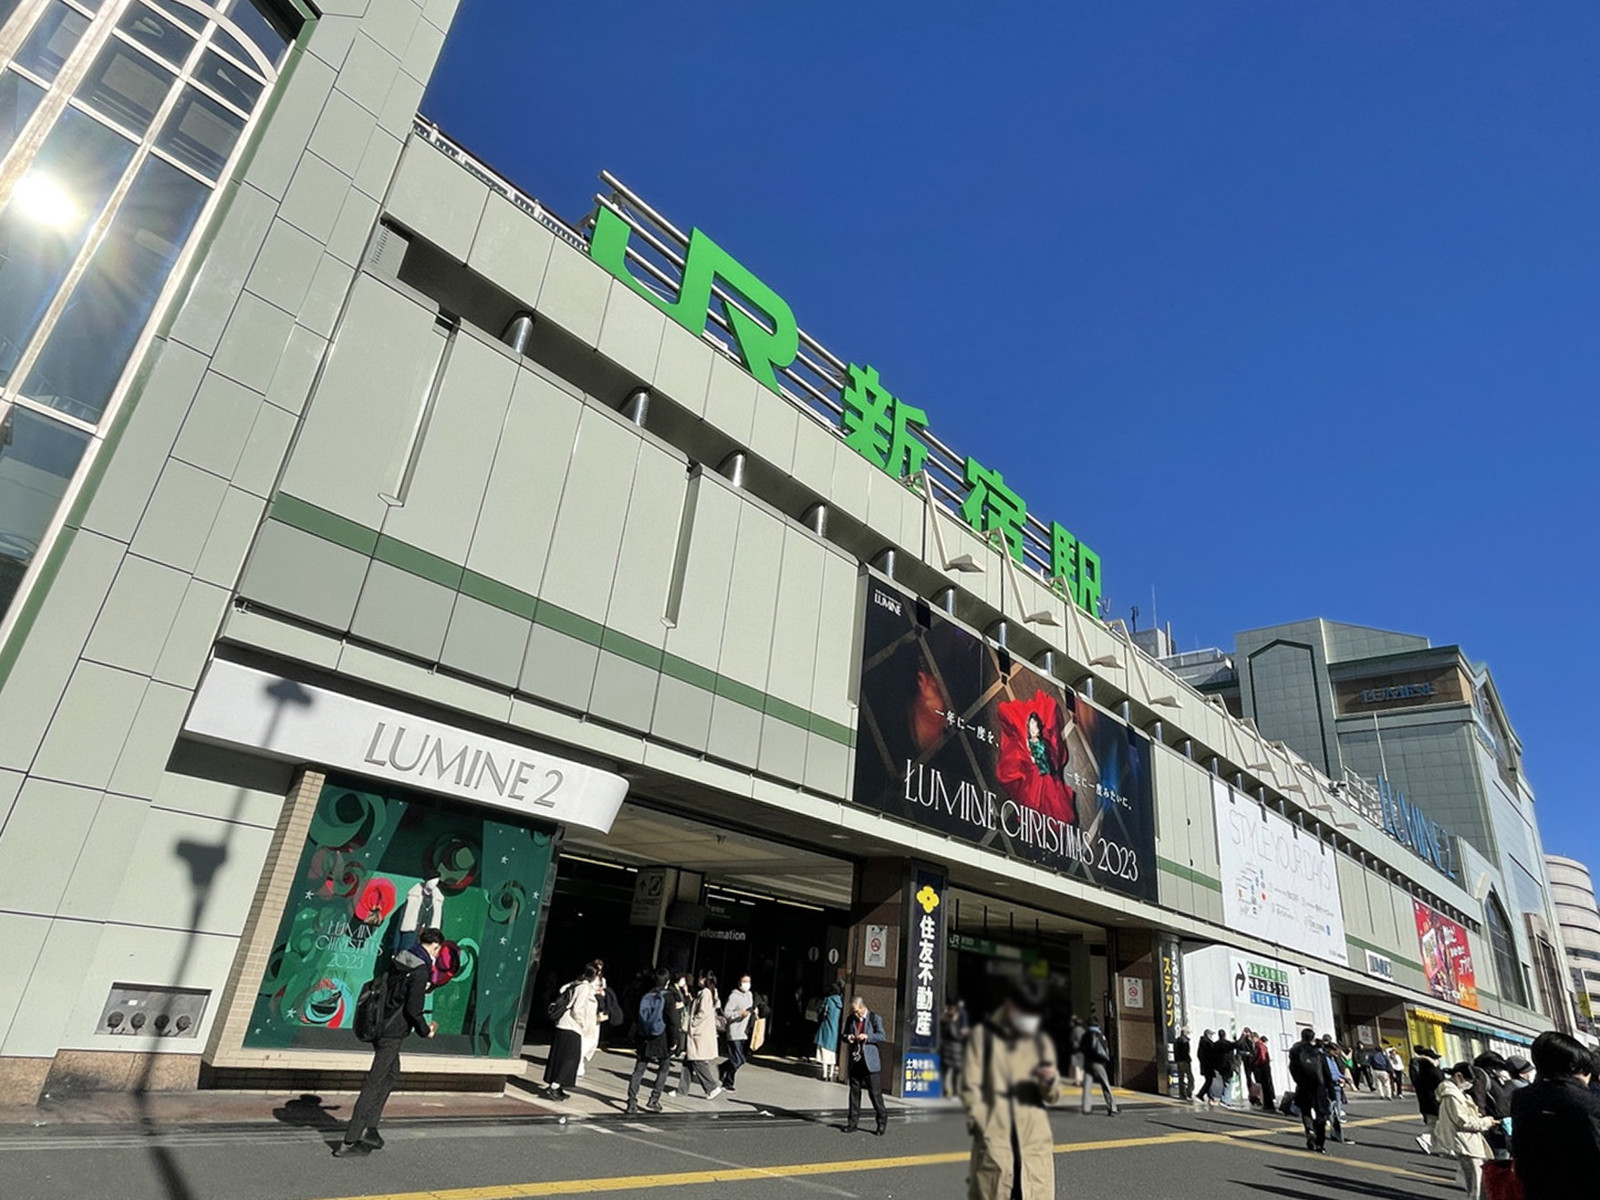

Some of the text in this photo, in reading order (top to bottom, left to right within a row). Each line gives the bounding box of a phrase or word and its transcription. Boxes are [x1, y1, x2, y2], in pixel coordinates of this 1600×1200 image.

[590, 206, 1103, 620] JR 新宿駅
[874, 592, 902, 617] LUMINE
[1360, 682, 1435, 704] LUMINE
[363, 720, 565, 808] LUMINE 2
[904, 757, 1139, 882] LUMINE CHRISTMAS 2023
[1376, 773, 1446, 873] LUMINE
[915, 915, 937, 1037] 住友不動産
[1162, 956, 1175, 1028] ステップ
